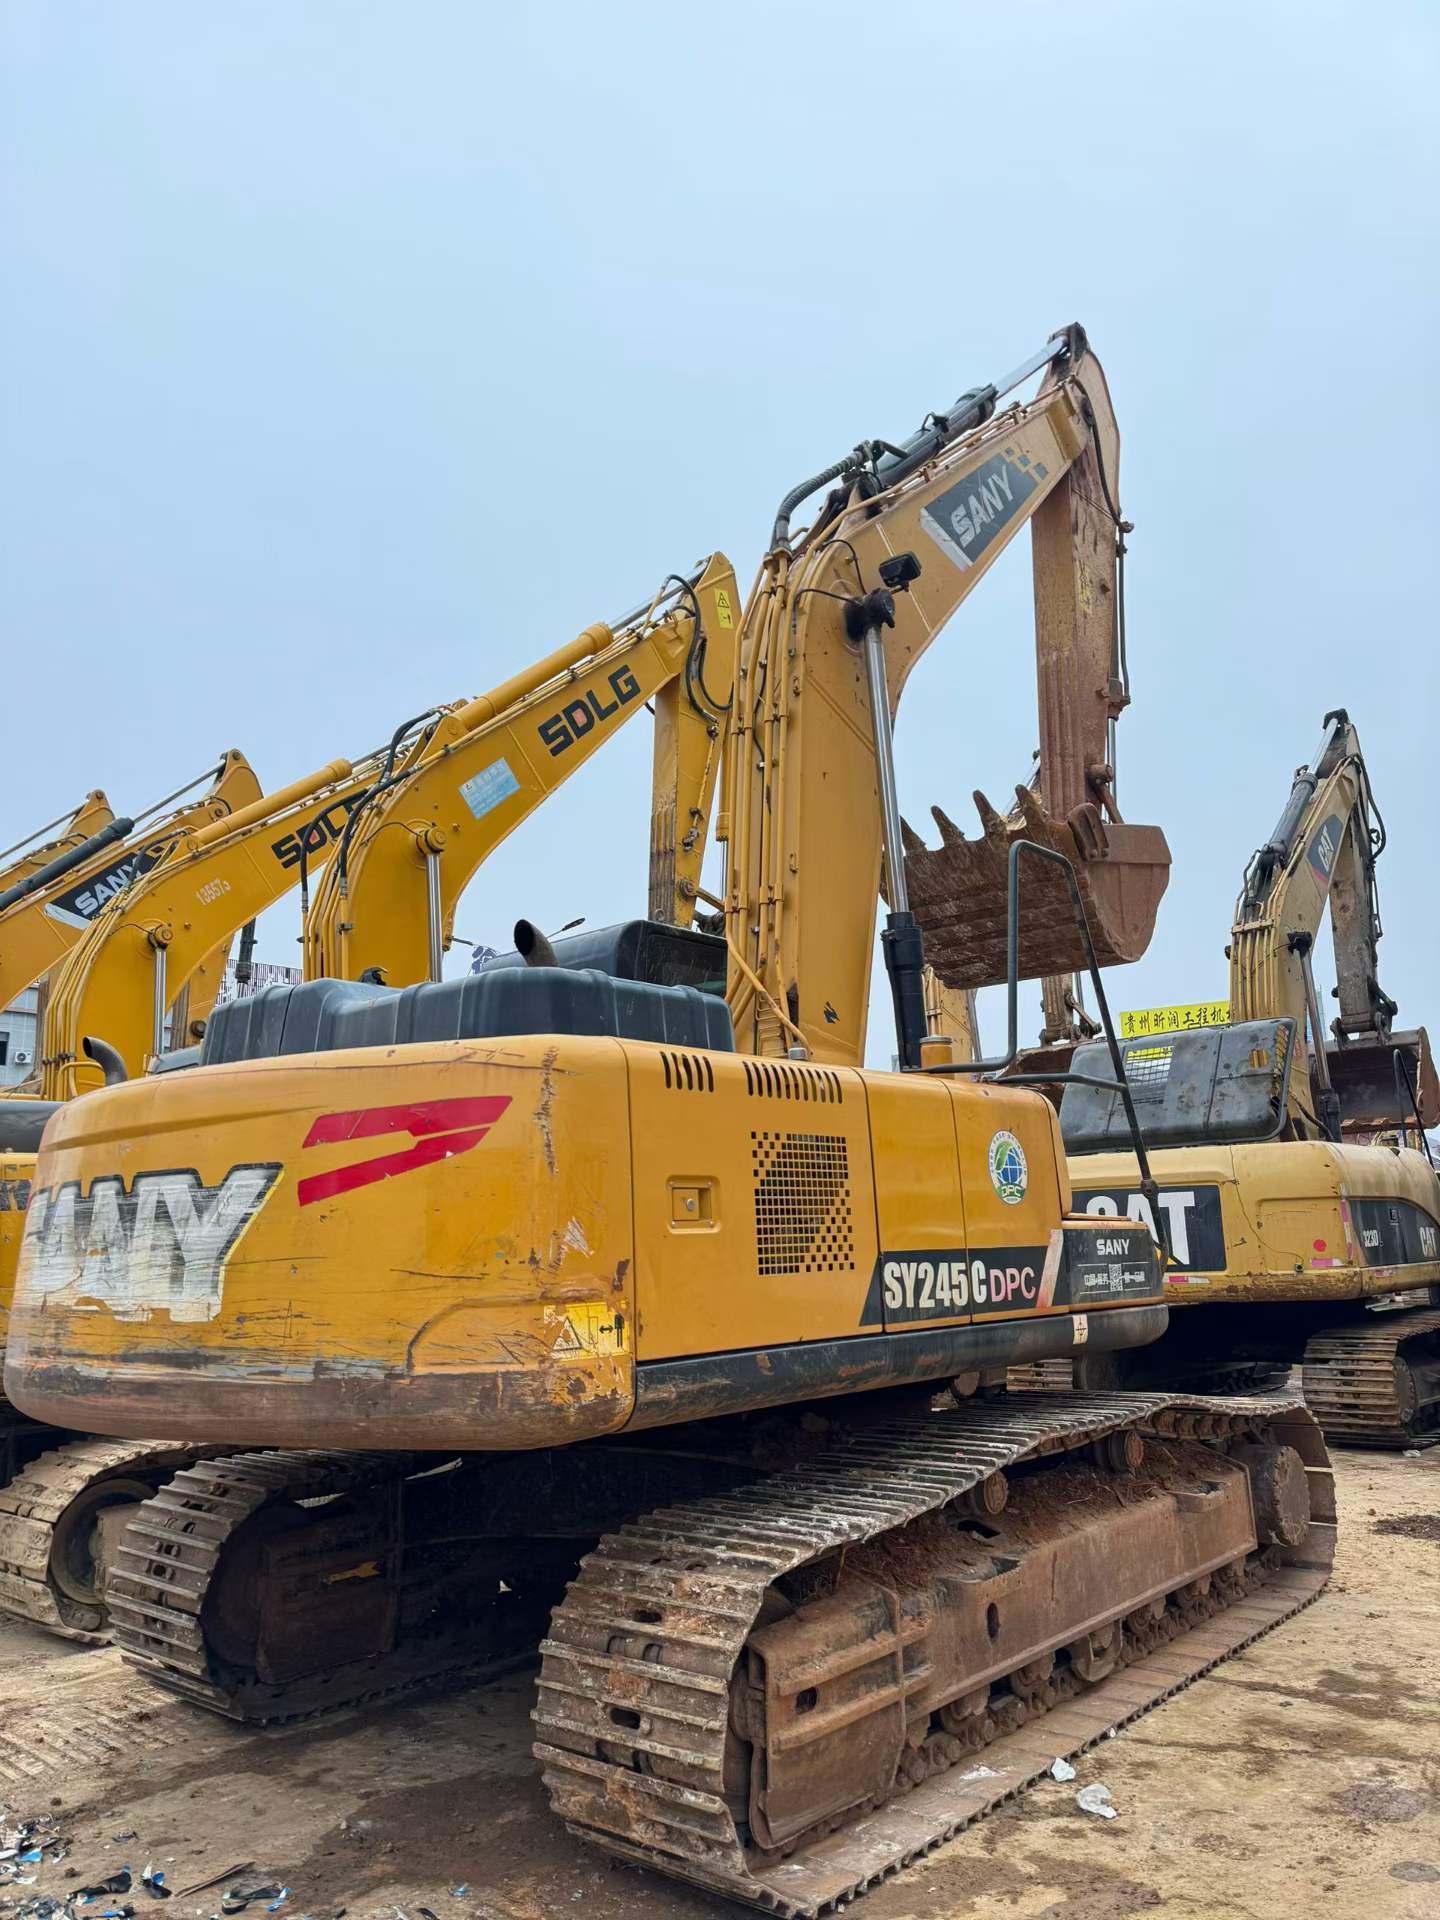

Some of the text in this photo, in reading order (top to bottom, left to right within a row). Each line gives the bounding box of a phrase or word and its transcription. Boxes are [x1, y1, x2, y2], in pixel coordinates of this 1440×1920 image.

[951, 464, 1014, 548] SANY
[538, 664, 641, 757] SDLG
[271, 790, 366, 869] SDL
[1125, 1006, 1232, 1033] 贵州昕润工程机
[1096, 1239, 1130, 1255] SANY
[1420, 1226, 1437, 1257] CAT
